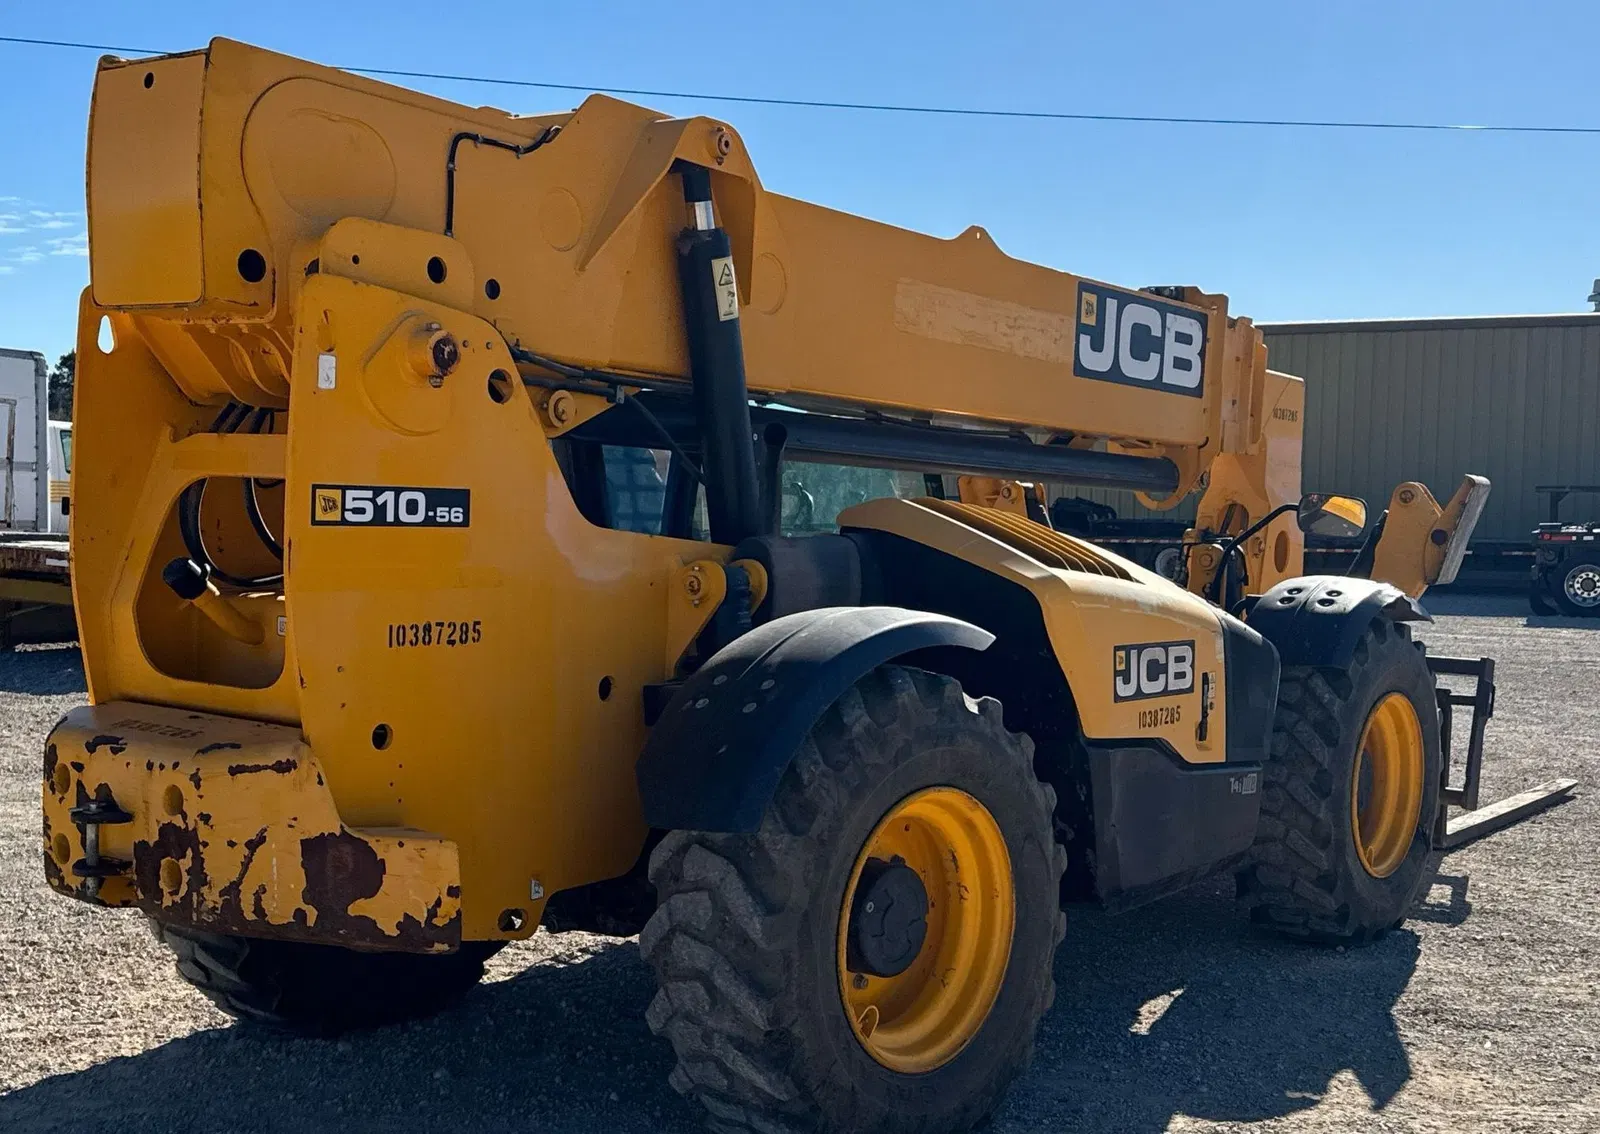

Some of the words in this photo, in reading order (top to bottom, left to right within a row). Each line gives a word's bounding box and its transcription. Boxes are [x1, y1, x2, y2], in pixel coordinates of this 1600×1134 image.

[1079, 297, 1202, 388] JCB
[321, 496, 339, 514] JCB
[388, 620, 482, 648] 10387285
[1116, 645, 1193, 697] JCB
[1138, 705, 1181, 730] 10387285
